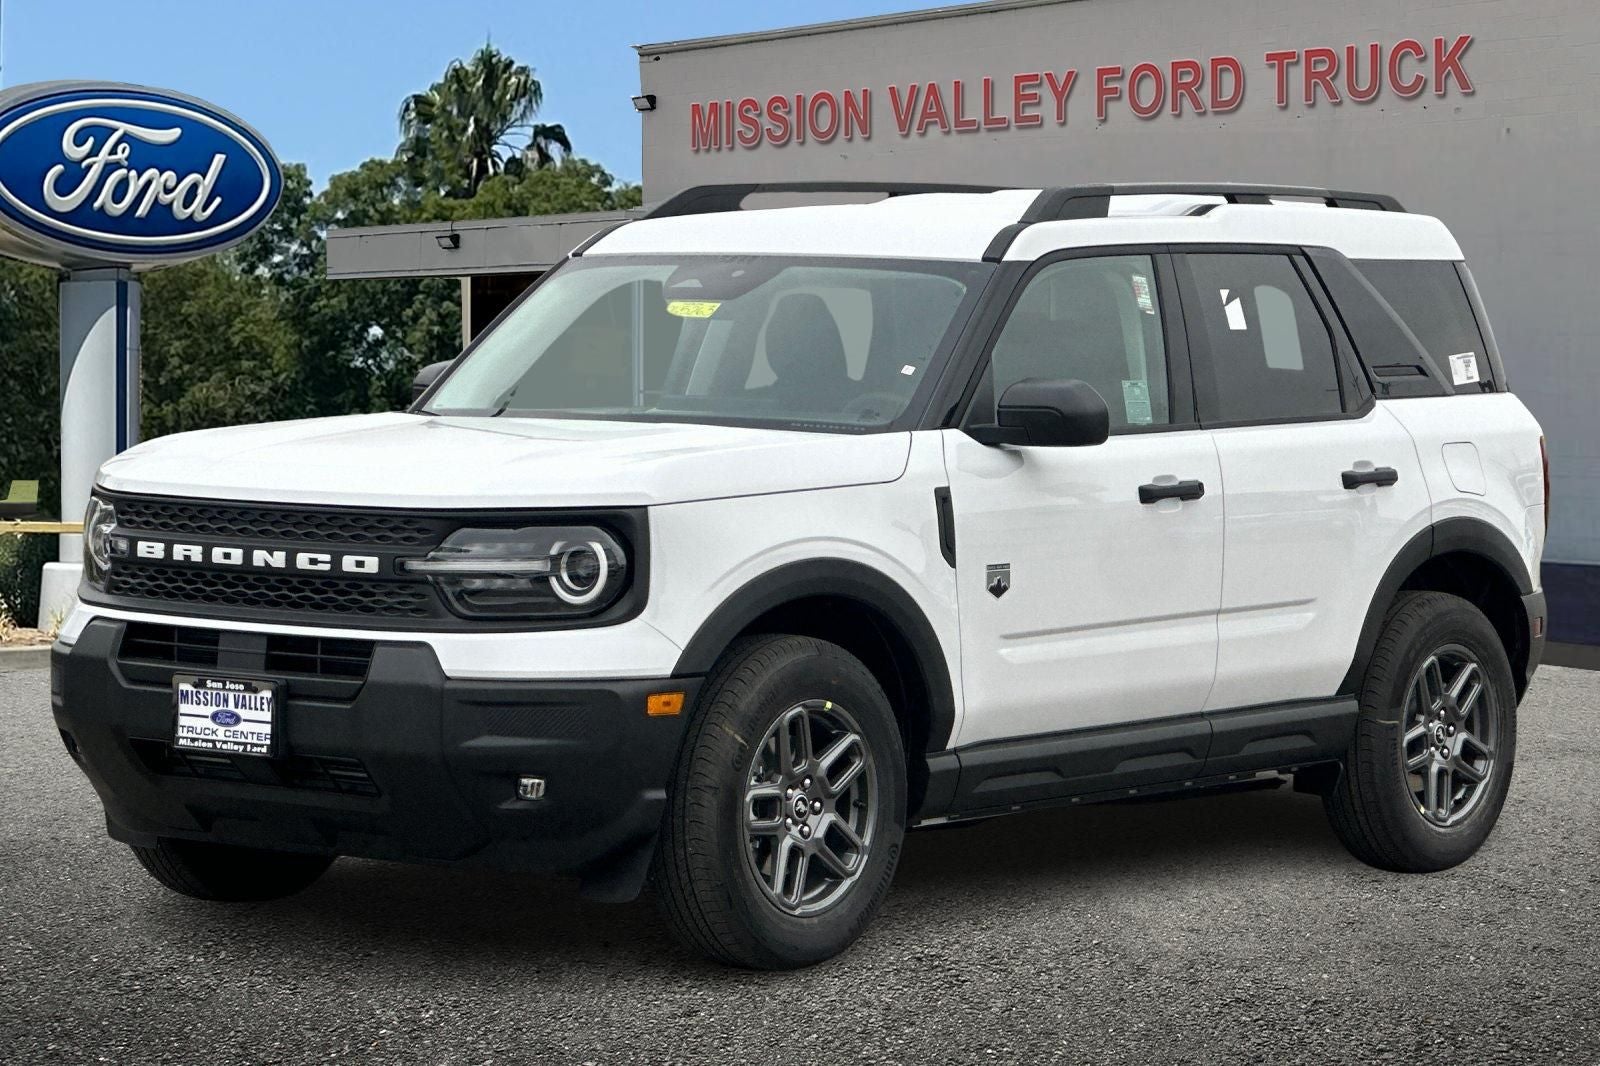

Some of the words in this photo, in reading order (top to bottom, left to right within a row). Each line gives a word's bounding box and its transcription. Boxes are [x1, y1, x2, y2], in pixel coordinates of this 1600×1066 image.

[690, 87, 871, 151] MISSION
[888, 68, 1078, 135] VALLEY
[1095, 54, 1244, 120] FORD
[1264, 34, 1474, 107] TRUCK
[43, 117, 227, 222] Ford
[136, 540, 380, 574] BRONCO
[206, 680, 223, 689] San
[180, 689, 229, 708] MISSION
[233, 693, 272, 712] VALLEY
[216, 712, 236, 725] Ford
[180, 725, 219, 737] TRUCK
[215, 741, 244, 752] Valley
